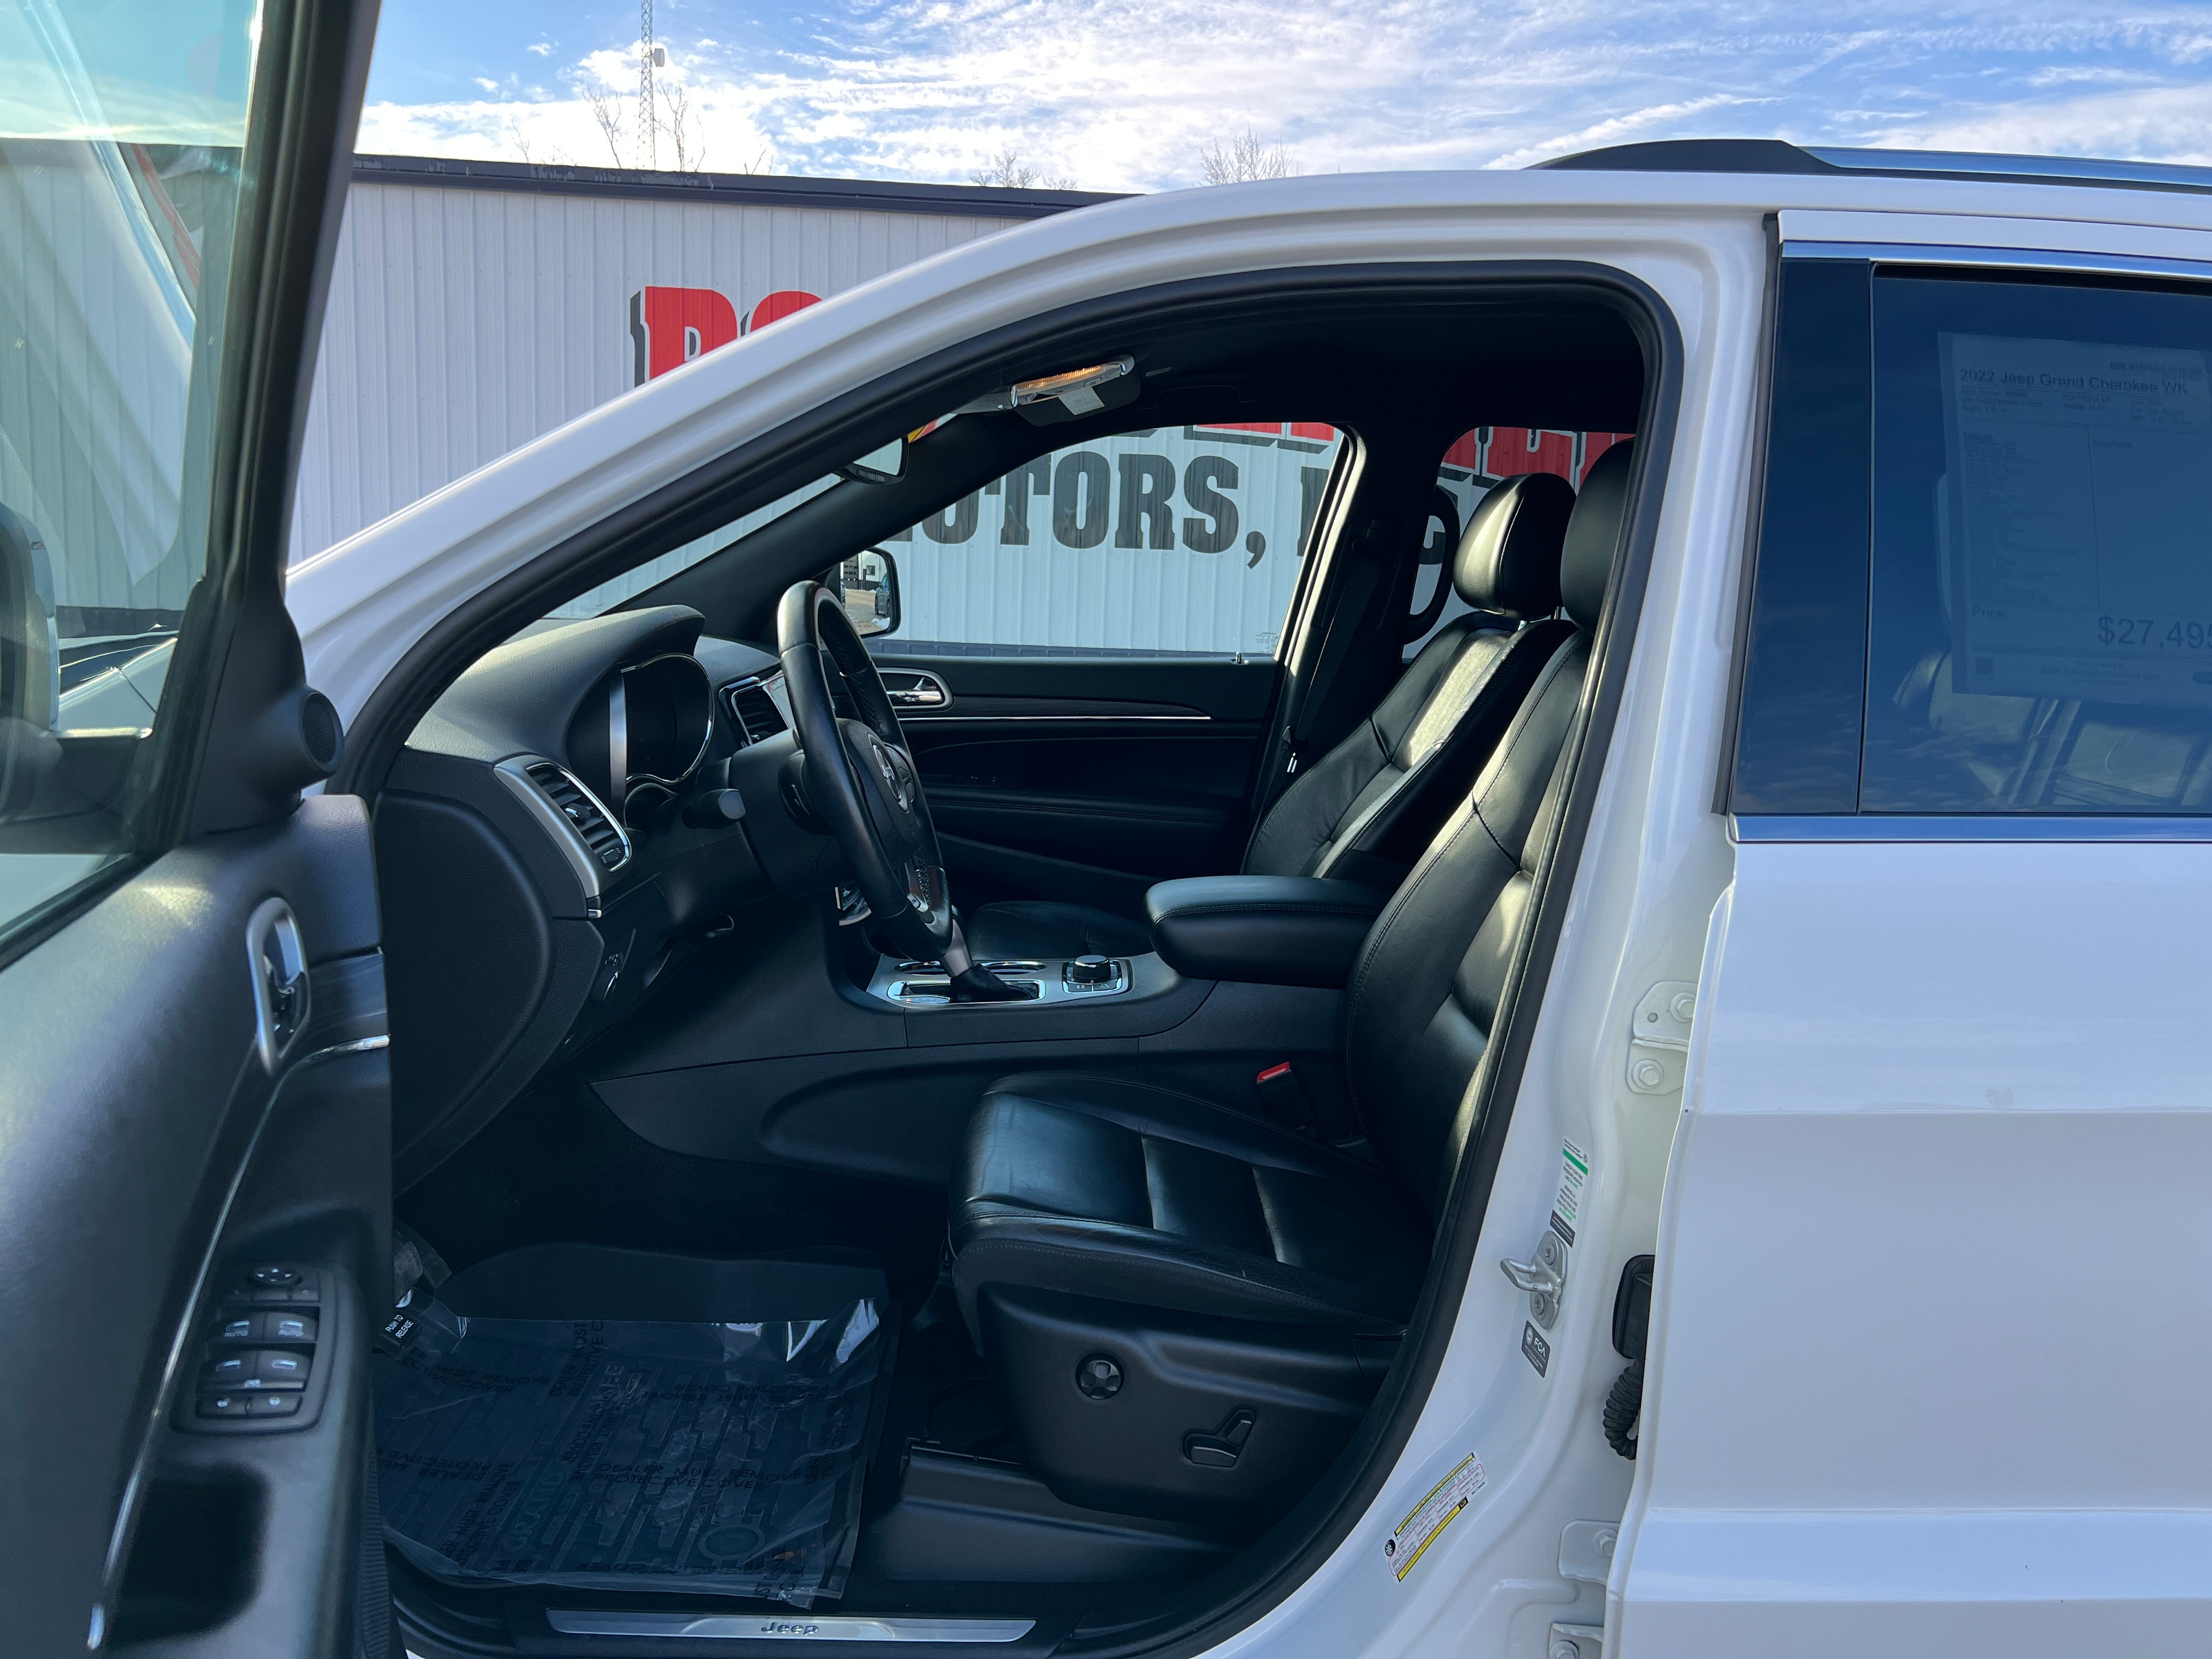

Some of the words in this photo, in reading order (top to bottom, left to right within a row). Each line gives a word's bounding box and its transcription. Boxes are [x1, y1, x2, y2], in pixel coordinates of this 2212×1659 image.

[1960, 368, 1995, 382] 2022
[2001, 372, 2035, 387] Jeep
[2040, 374, 2084, 388] Grand
[2089, 377, 2158, 393] Cherokee
[2162, 380, 2188, 394] WK
[884, 451, 1266, 570] OTORS,
[385, 1321, 399, 1333] PUSH
[395, 1319, 414, 1339] RELEASE
[567, 1337, 603, 1397] PROTECTIVE
[592, 1474, 697, 1487] PROTECTIVE
[703, 1480, 765, 1491] COVER
[599, 1464, 664, 1474] DEALER
[674, 1467, 720, 1477] MUST
[729, 1469, 802, 1482] REMOVE
[488, 1481, 521, 1515] COVER
[761, 1622, 819, 1635] Jeep
